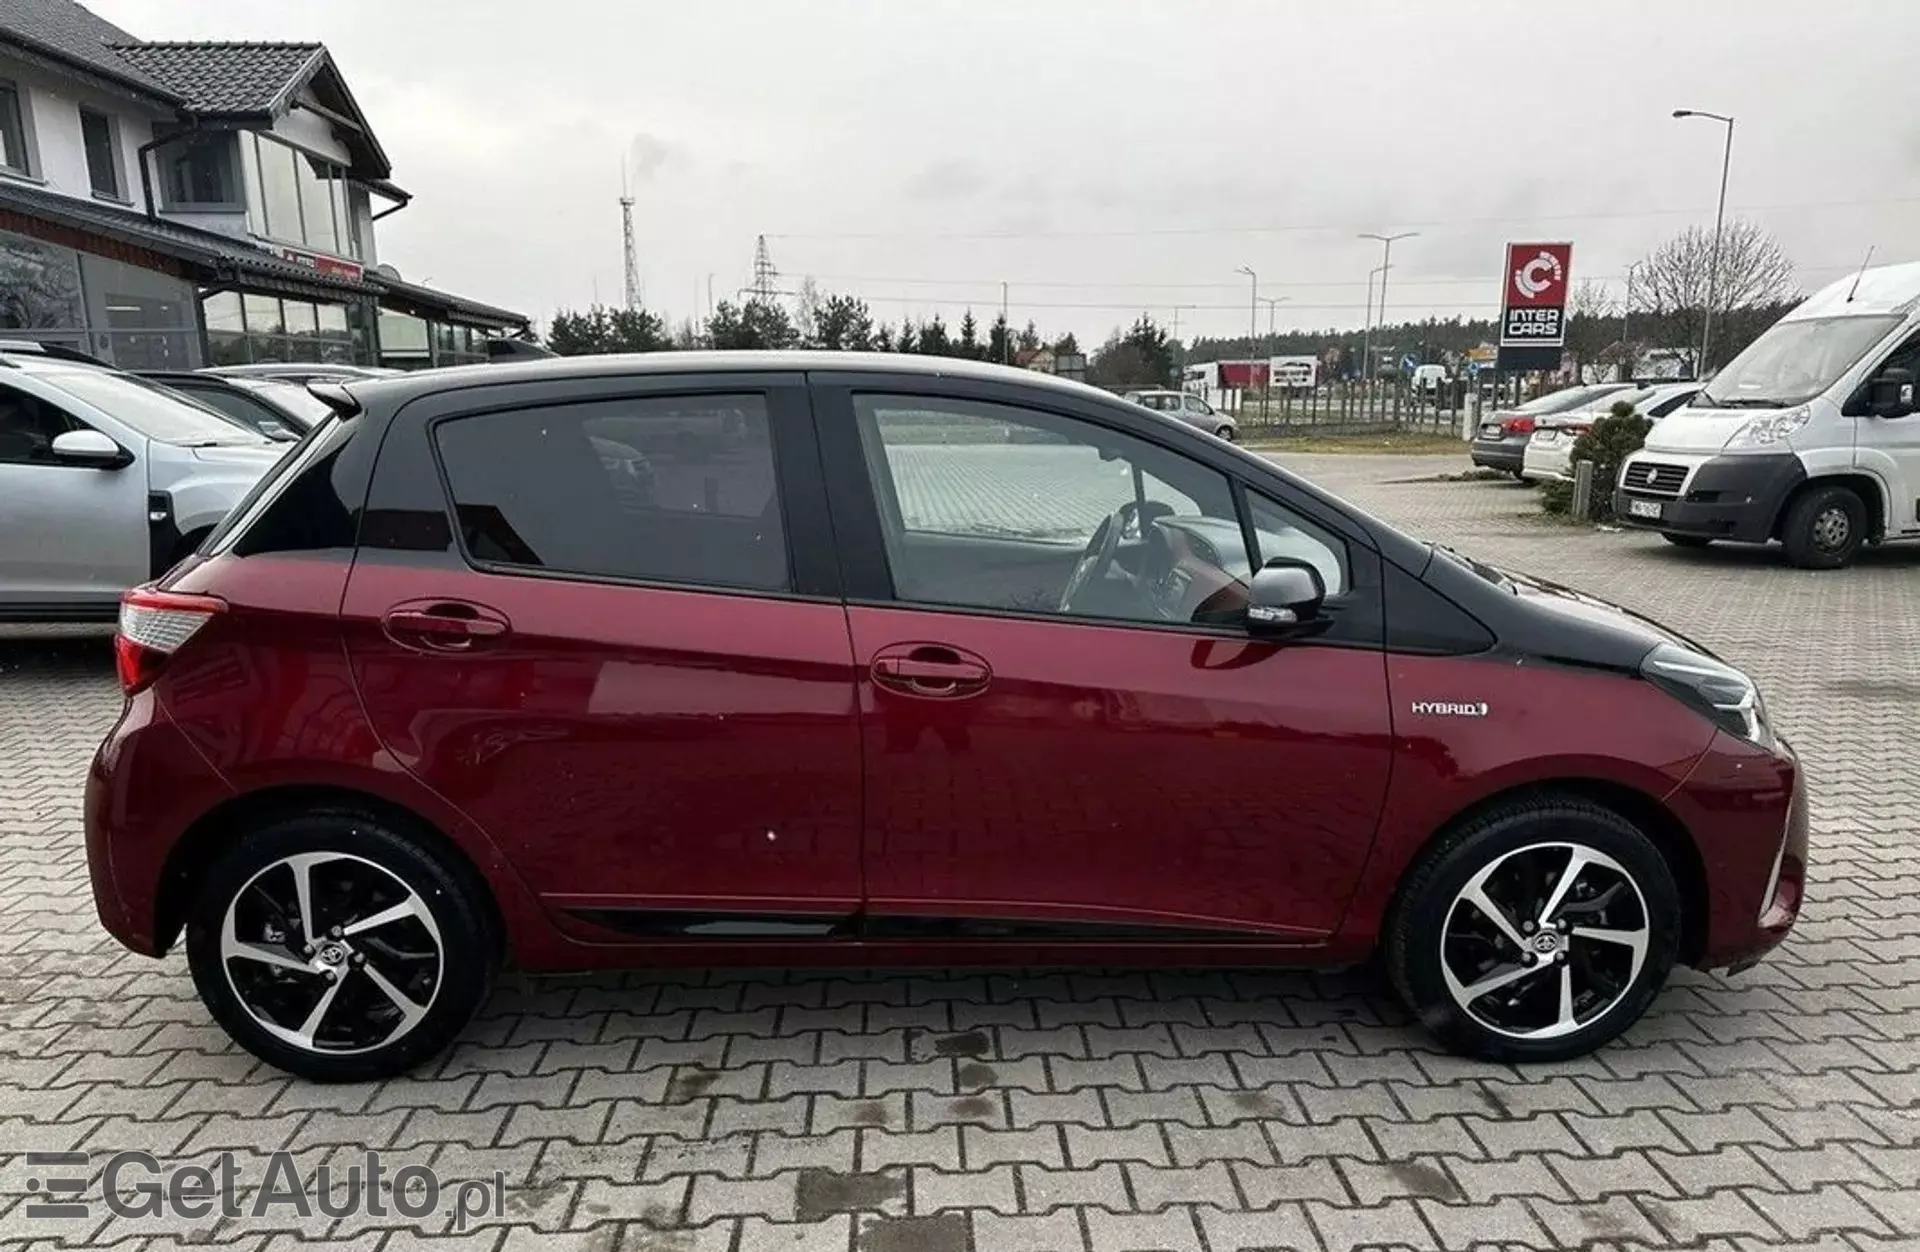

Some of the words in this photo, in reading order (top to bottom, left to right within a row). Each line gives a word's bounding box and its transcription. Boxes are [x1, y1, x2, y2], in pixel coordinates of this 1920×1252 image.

[1509, 309, 1559, 321] INTER
[1508, 322, 1557, 335] CARS
[1411, 701, 1477, 716] HYBRID
